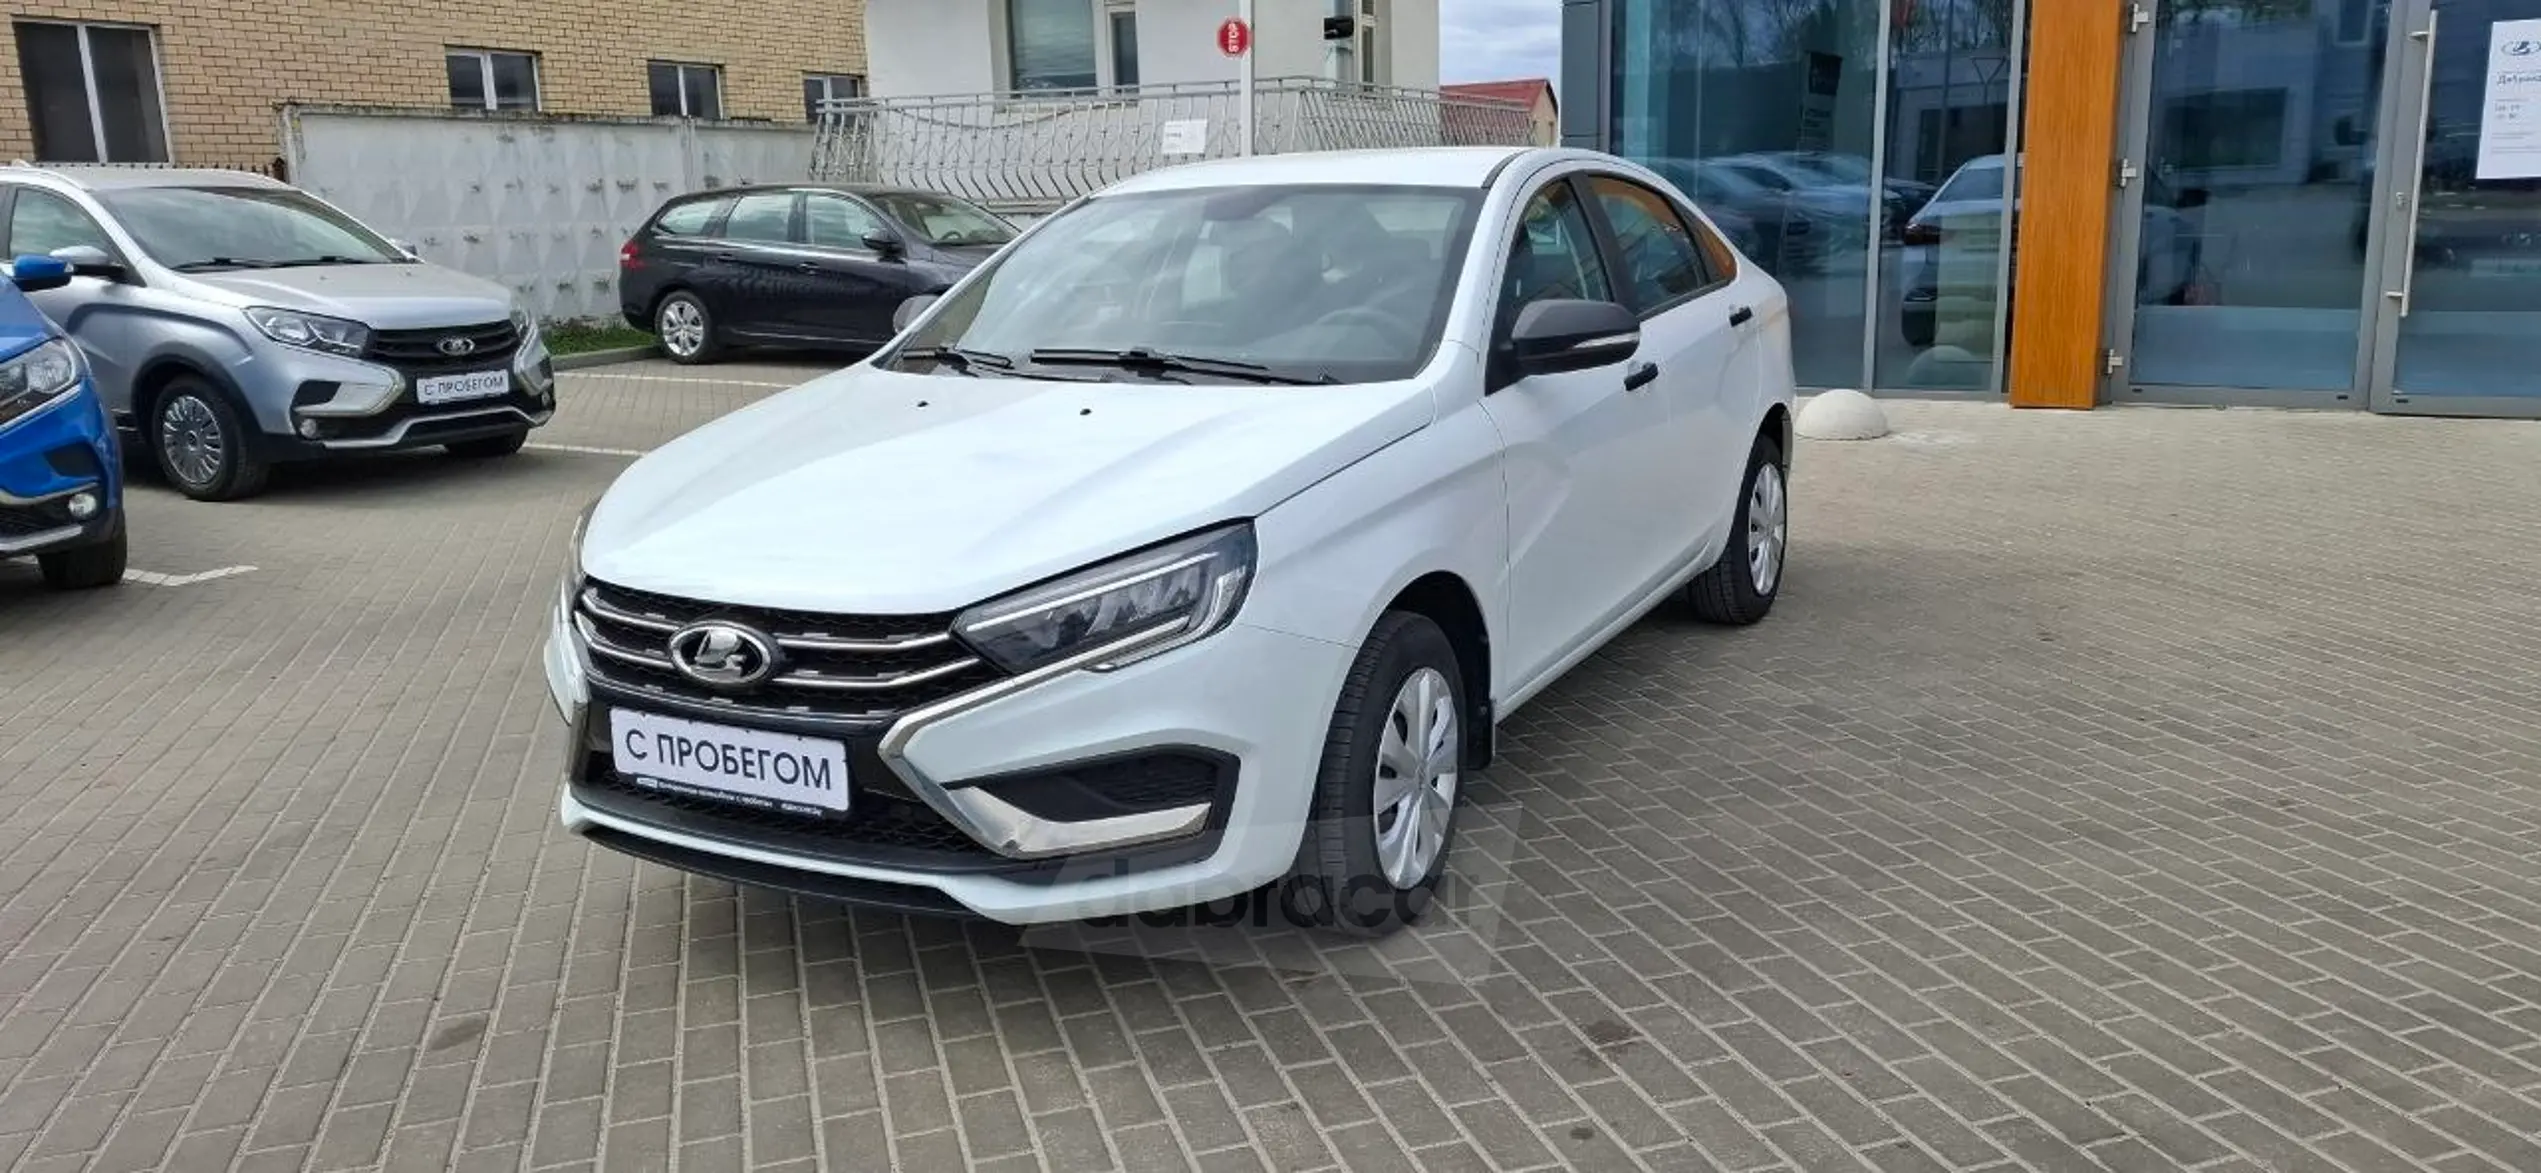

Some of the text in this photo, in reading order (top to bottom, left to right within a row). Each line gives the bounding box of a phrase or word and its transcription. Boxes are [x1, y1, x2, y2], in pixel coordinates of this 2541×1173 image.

[1228, 22, 1239, 52] STOP
[438, 376, 504, 394] ПРОБЕГОМ
[626, 728, 832, 790] С ПРОБЕГОМ
